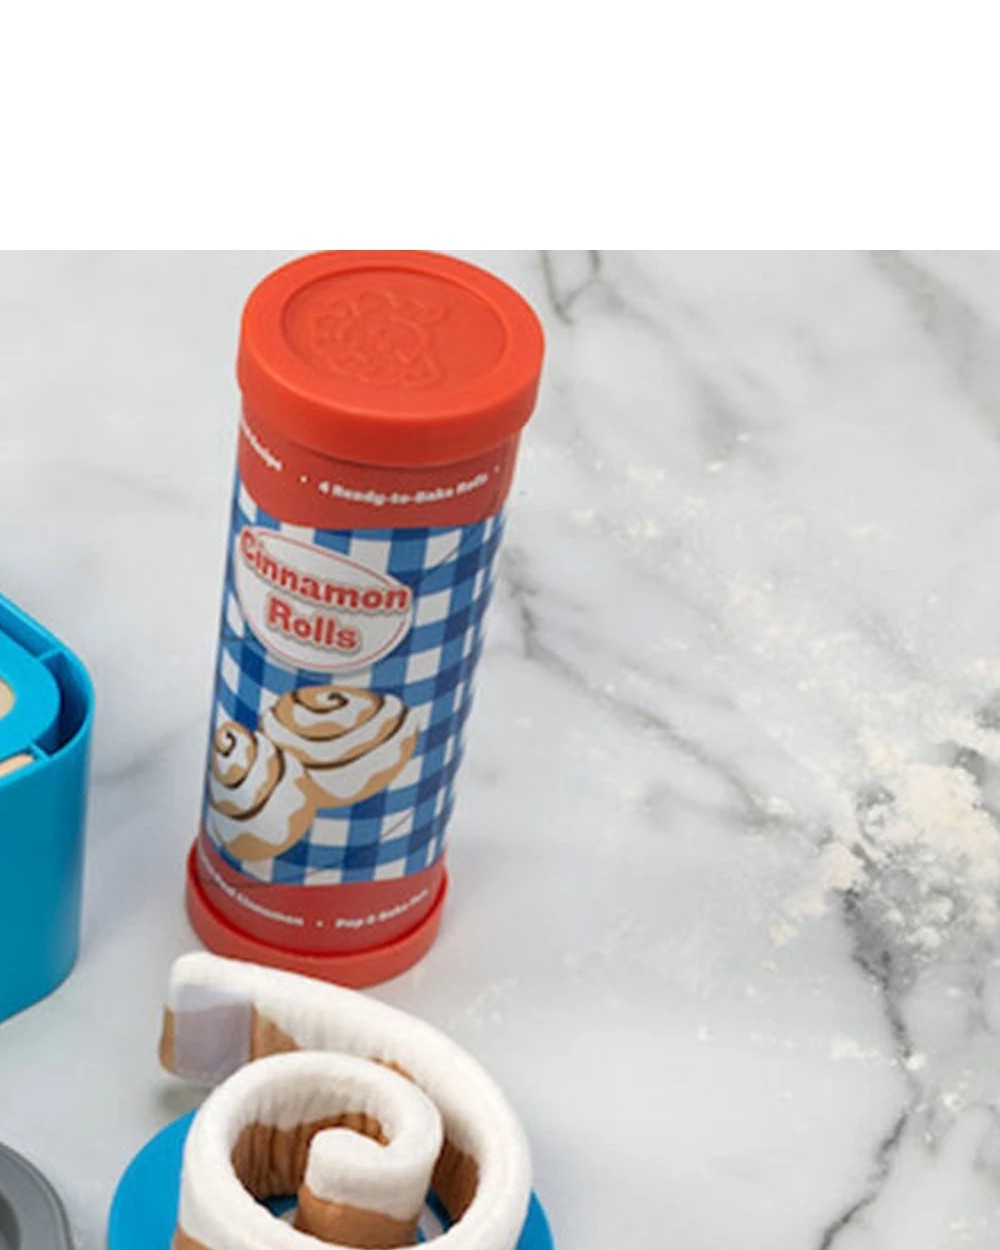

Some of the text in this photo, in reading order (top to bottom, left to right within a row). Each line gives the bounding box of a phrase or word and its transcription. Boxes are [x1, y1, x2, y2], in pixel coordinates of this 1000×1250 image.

[318, 481, 330, 494] 4
[240, 528, 409, 610] Cinnamon
[267, 597, 358, 650] Rolls
